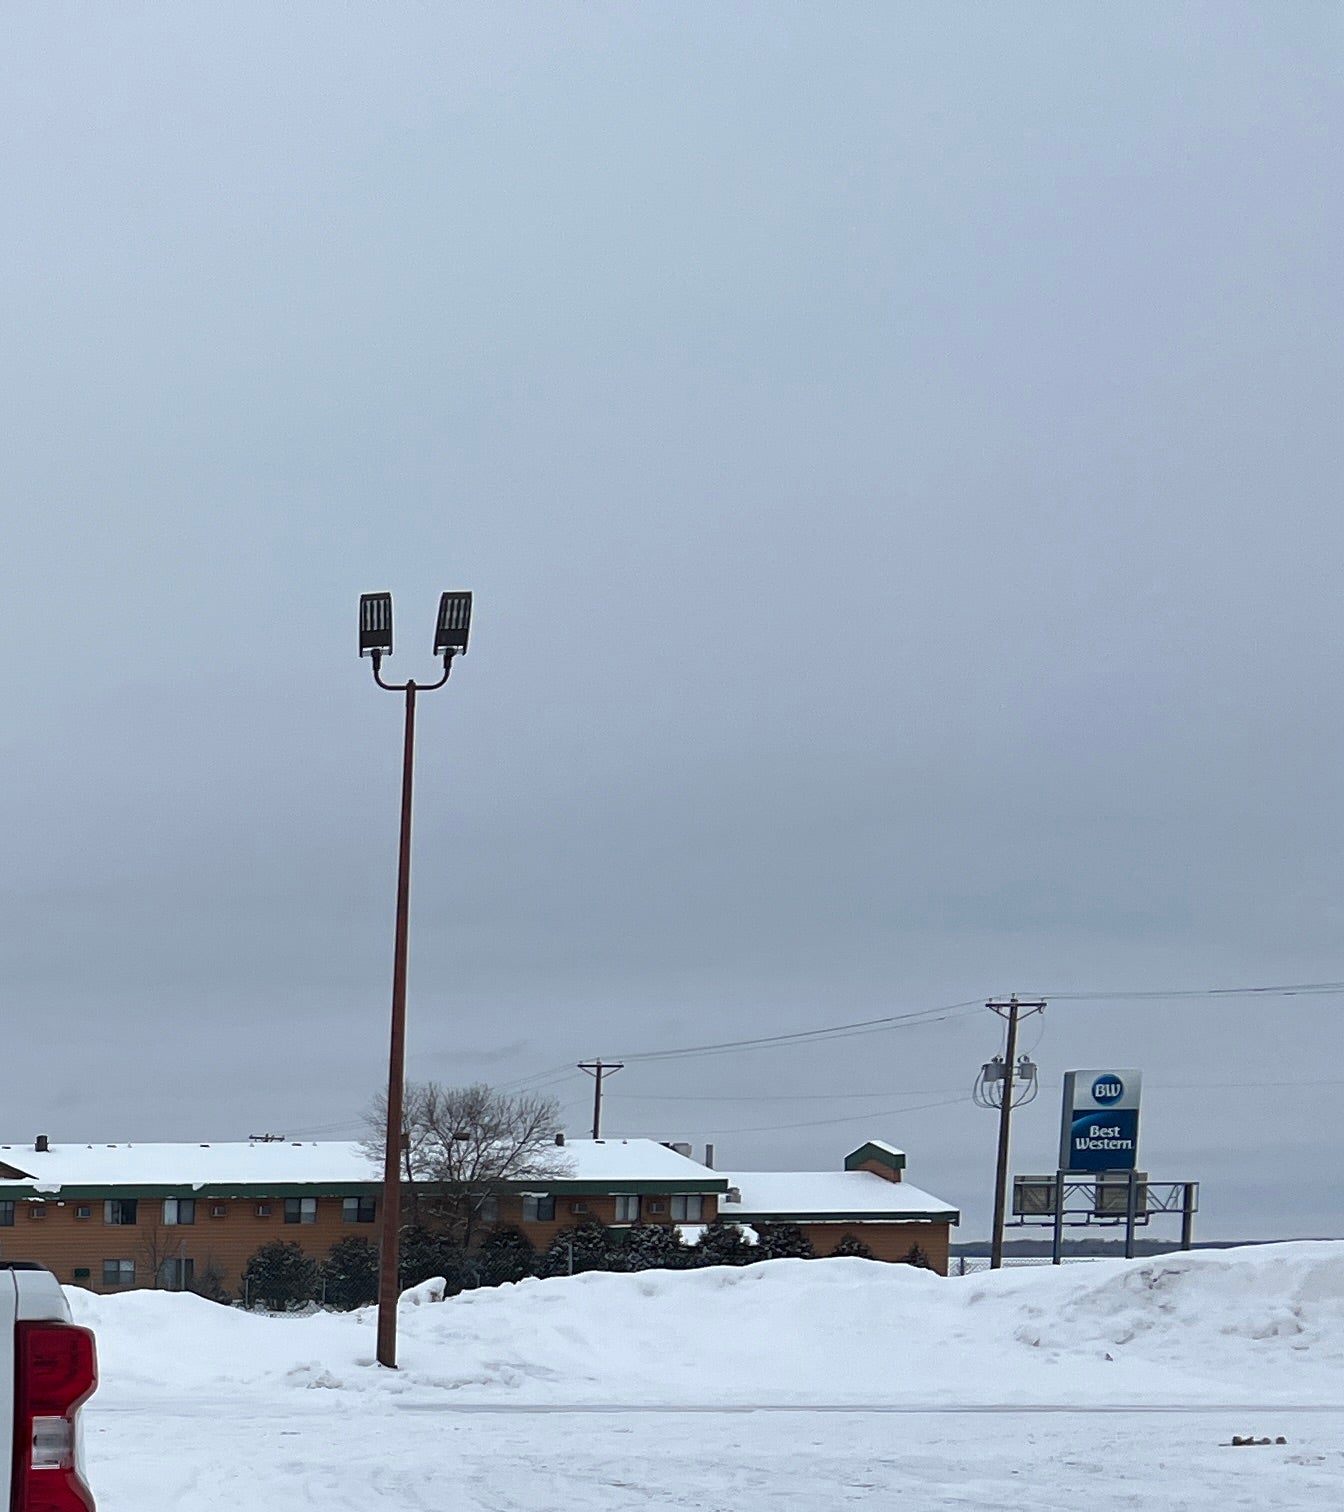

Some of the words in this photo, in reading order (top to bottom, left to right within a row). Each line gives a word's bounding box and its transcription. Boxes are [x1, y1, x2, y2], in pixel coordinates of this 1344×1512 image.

[1095, 1083, 1121, 1098] BW
[1089, 1125, 1120, 1138] Best
[1075, 1137, 1132, 1150] Western
